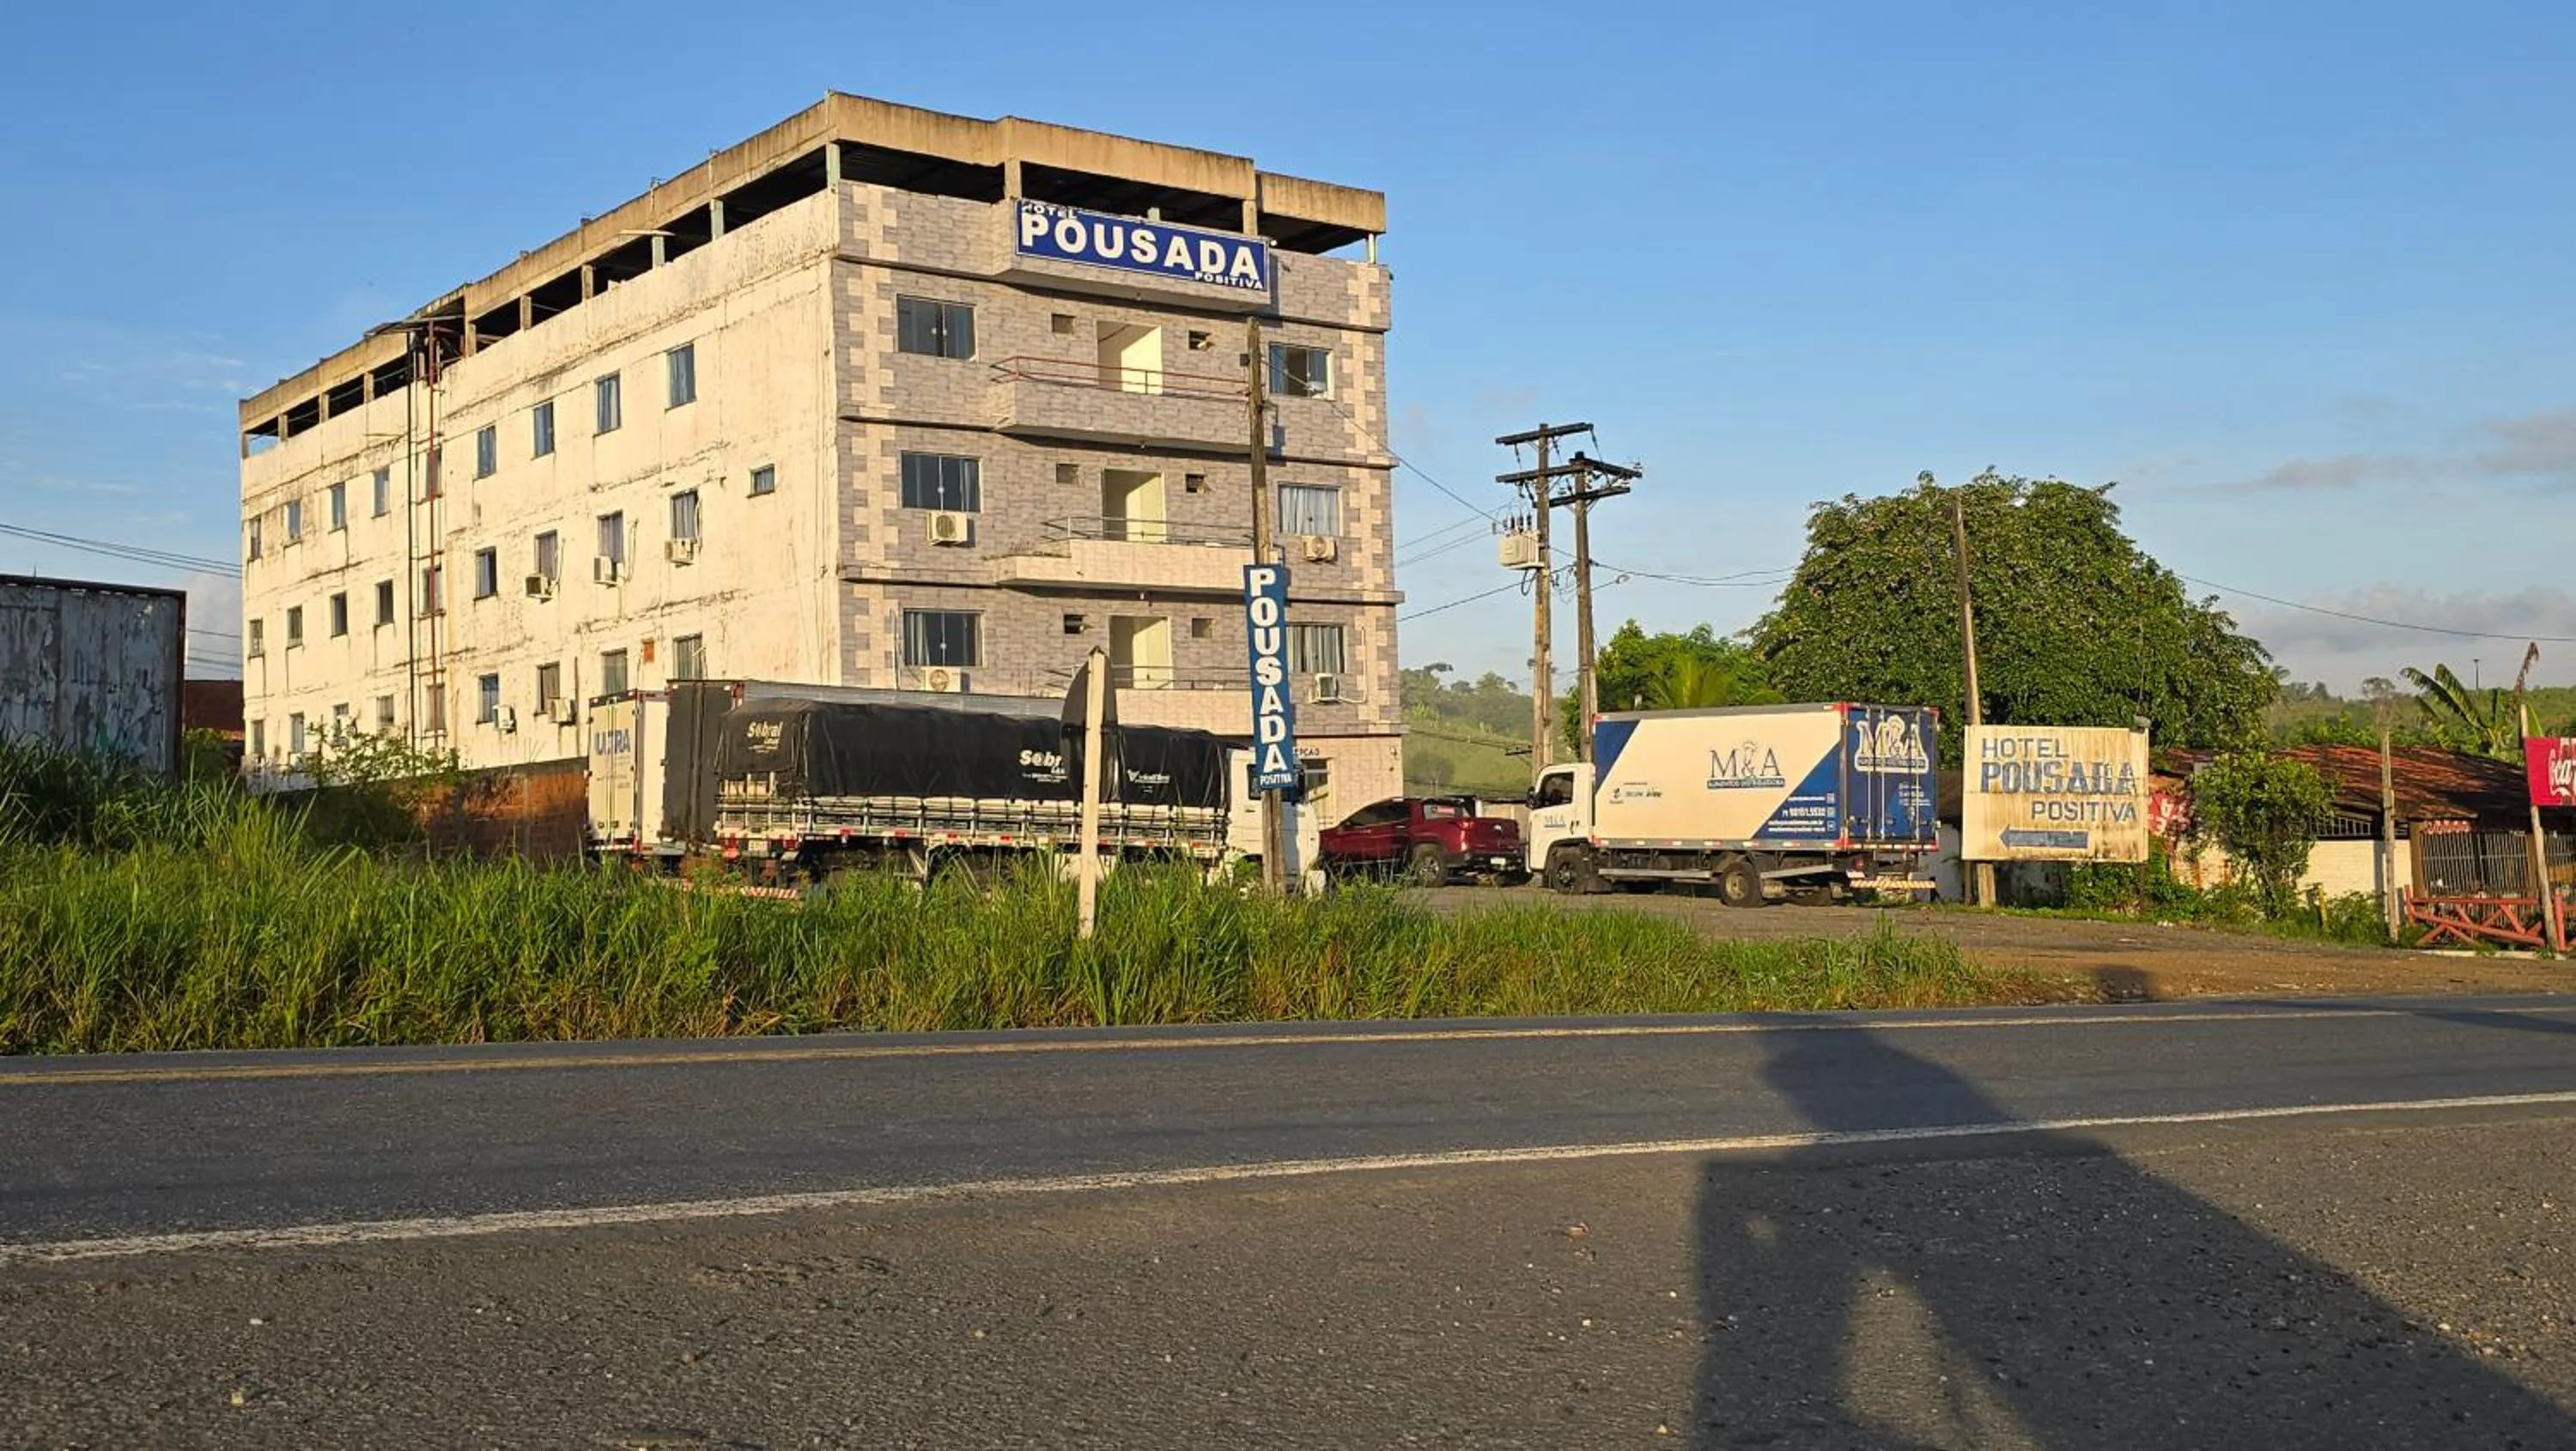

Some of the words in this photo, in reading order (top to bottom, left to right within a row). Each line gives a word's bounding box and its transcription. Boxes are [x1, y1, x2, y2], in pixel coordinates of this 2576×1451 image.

[1021, 213, 1260, 281] POUSADA
[1194, 270, 1263, 289] POSITIVA
[1249, 568, 1287, 774] POUSADA
[1019, 750, 1065, 767] Sobr
[1710, 745, 1781, 778] M&A
[1982, 738, 2069, 758] HOTEL
[1981, 762, 2138, 795] POUSADA
[2031, 800, 2137, 822] POSITIVA
